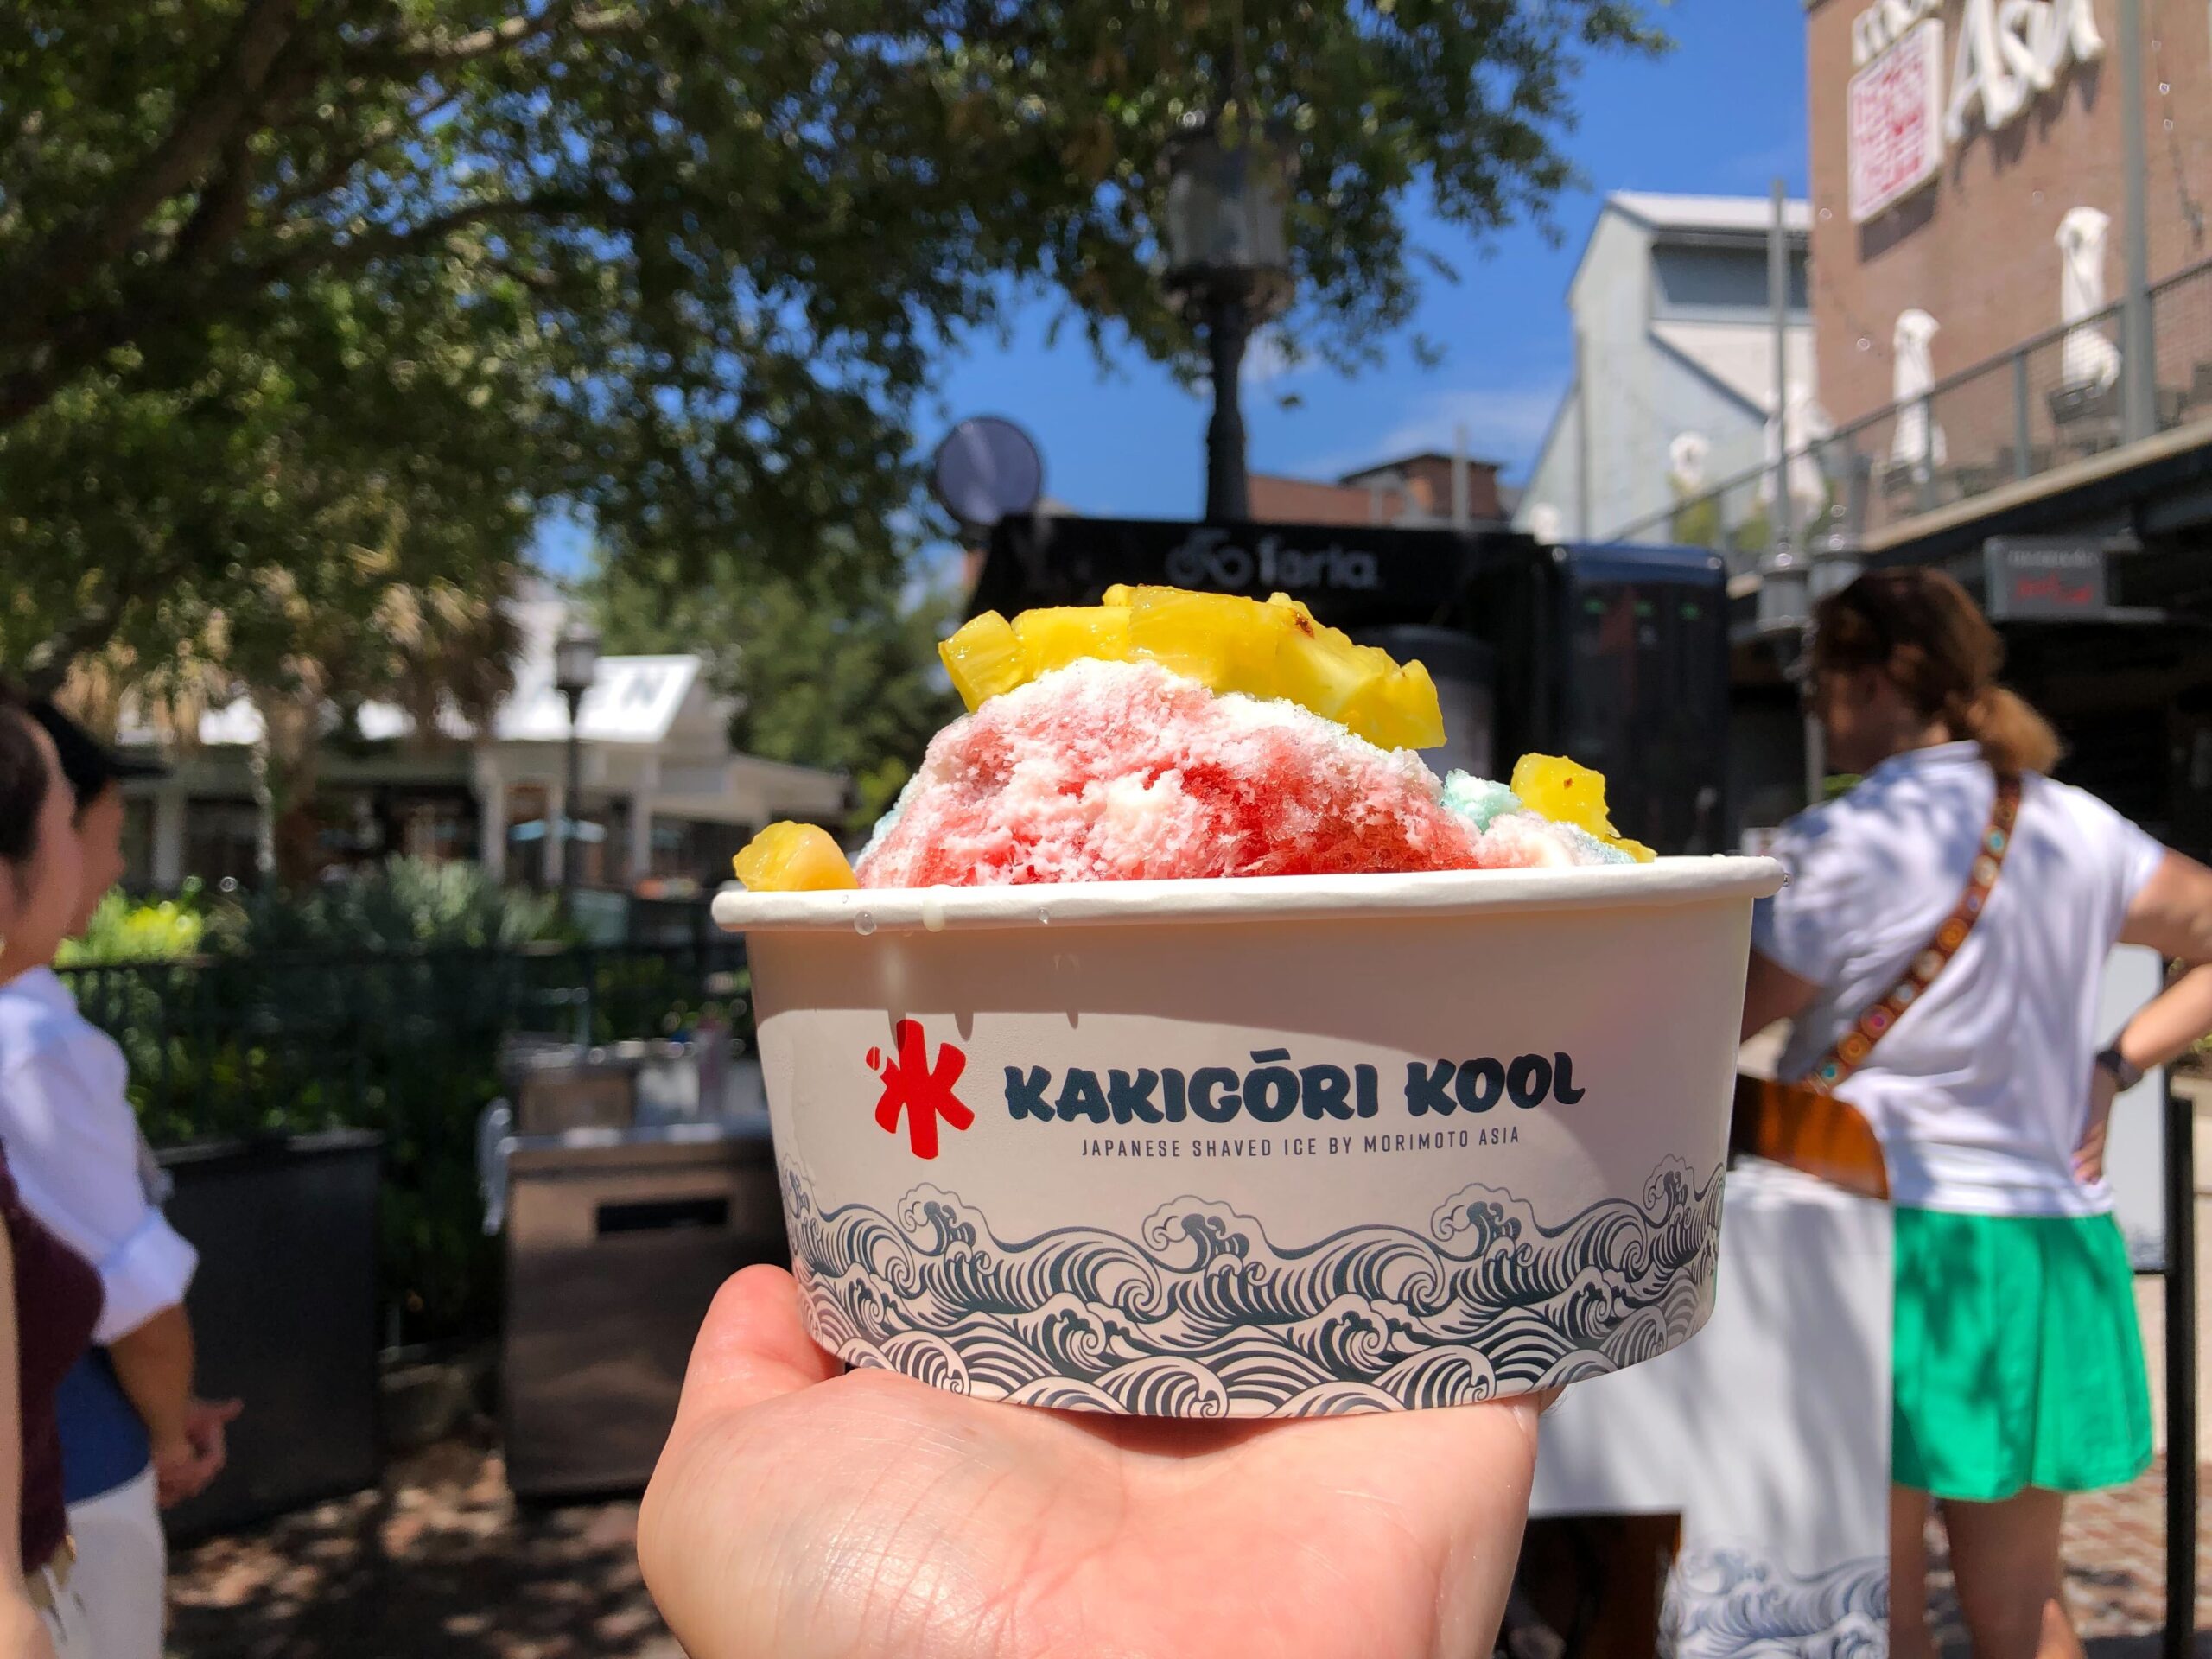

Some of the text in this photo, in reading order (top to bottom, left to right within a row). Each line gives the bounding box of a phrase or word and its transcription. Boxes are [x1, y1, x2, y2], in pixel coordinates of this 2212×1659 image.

[1004, 1047, 1586, 1125] KAKIGŌRI KOOL
[1082, 1126, 1520, 1158] JAPANESE SHAVED ICE BY MORIMOTO ASIA
